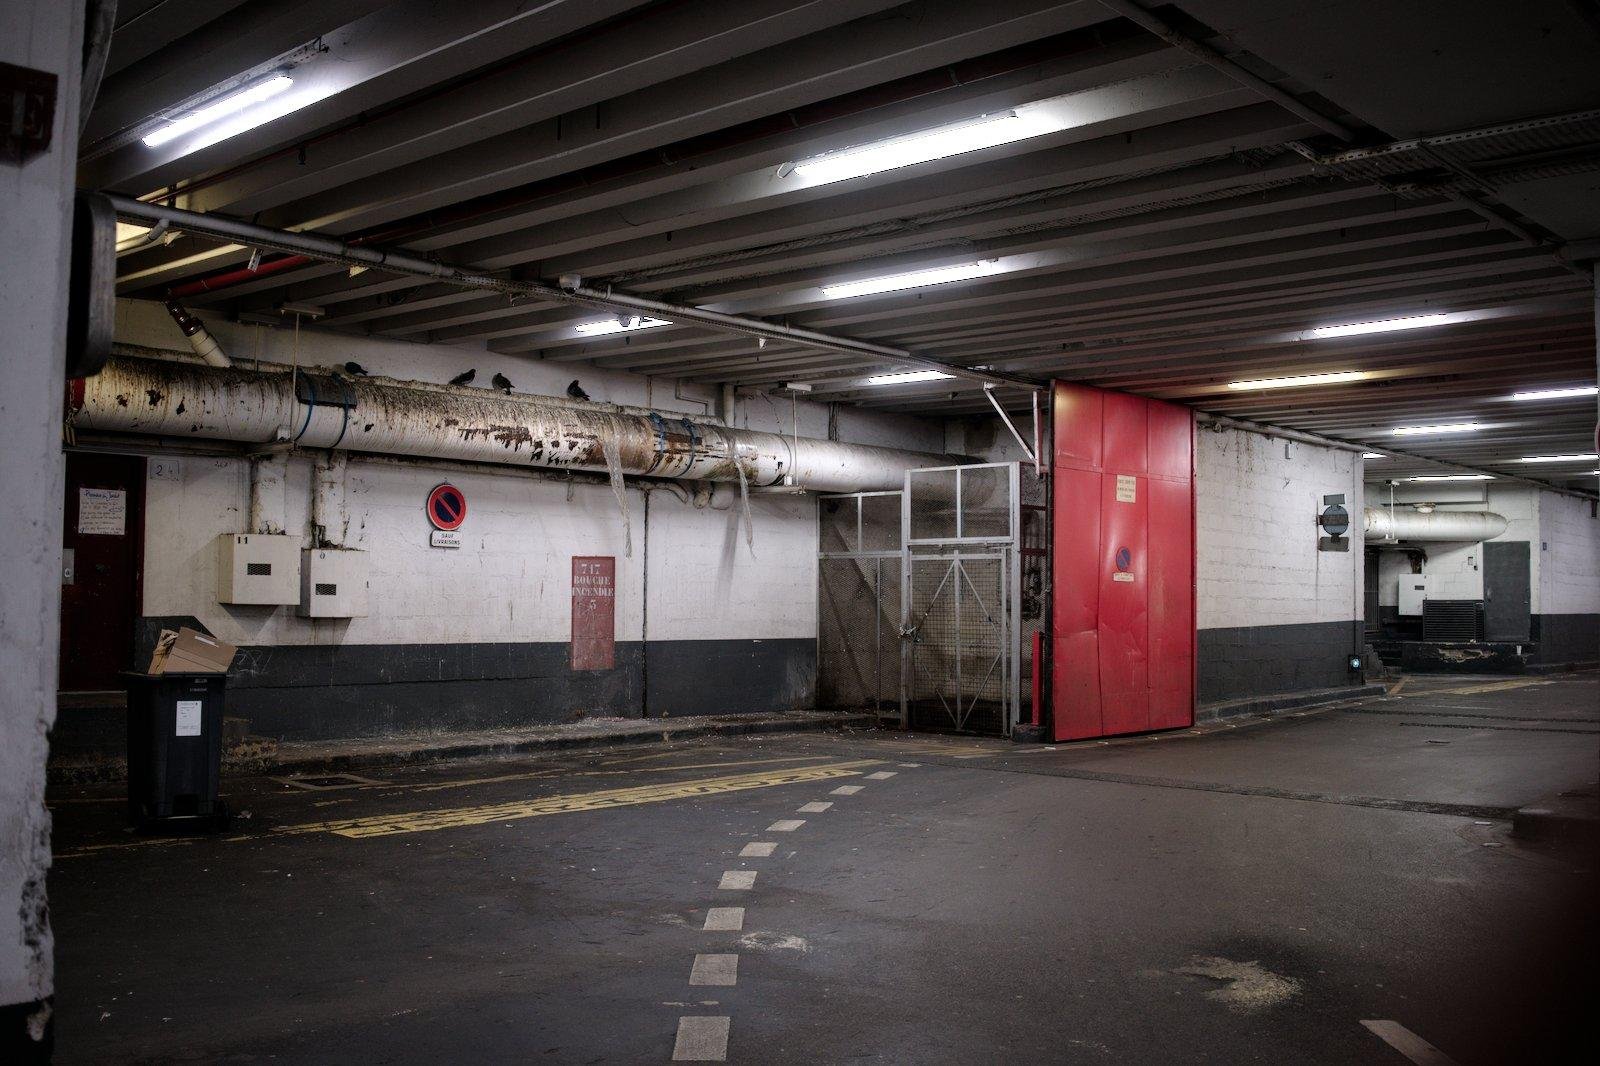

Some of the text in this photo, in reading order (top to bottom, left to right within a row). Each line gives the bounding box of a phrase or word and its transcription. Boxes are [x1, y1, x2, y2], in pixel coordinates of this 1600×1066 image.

[238, 536, 248, 544] 11
[573, 575, 611, 585] BOUCHE
[572, 587, 614, 596] INCENDIE
